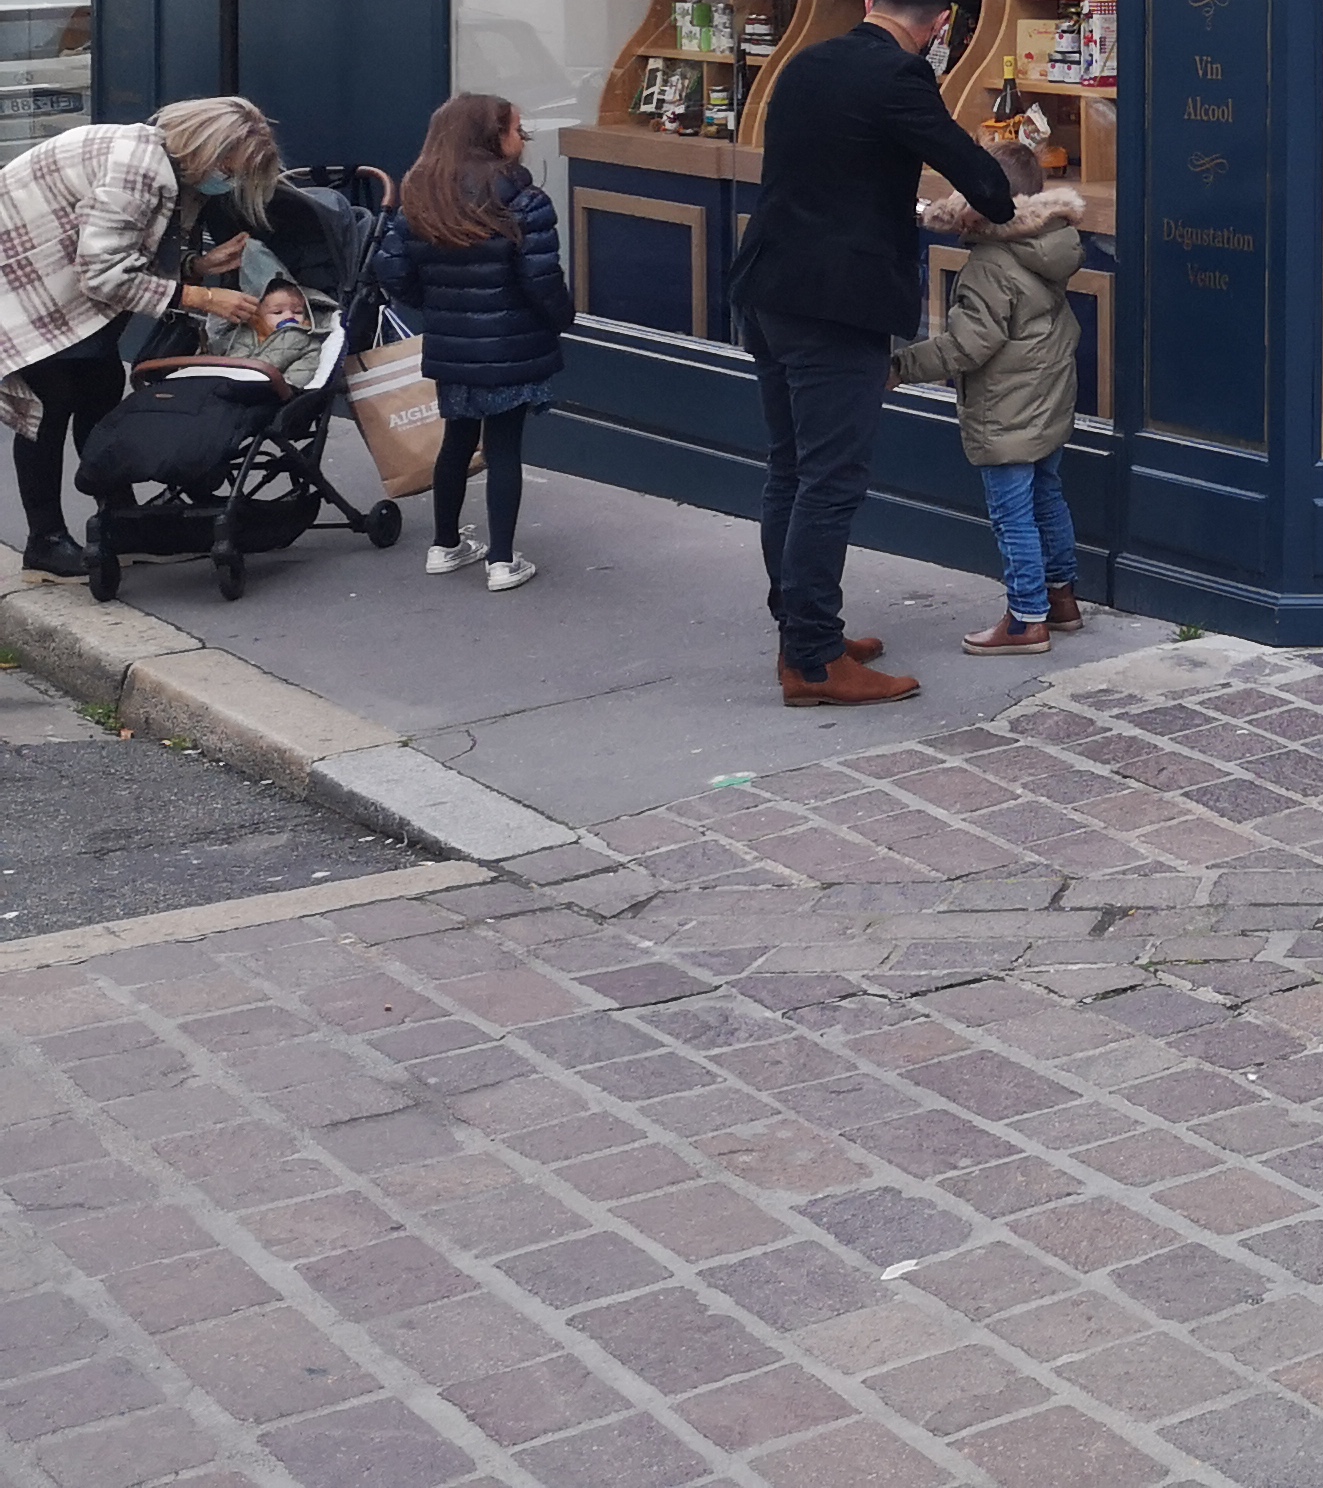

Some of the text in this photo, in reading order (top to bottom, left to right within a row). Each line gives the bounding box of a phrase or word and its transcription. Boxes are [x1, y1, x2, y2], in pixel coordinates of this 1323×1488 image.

[1194, 56, 1222, 81] Vin
[1183, 100, 1233, 123] Alcool
[1163, 218, 1254, 251] Dégustation
[1187, 263, 1229, 290] Vente
[389, 399, 440, 429] AIGLE
